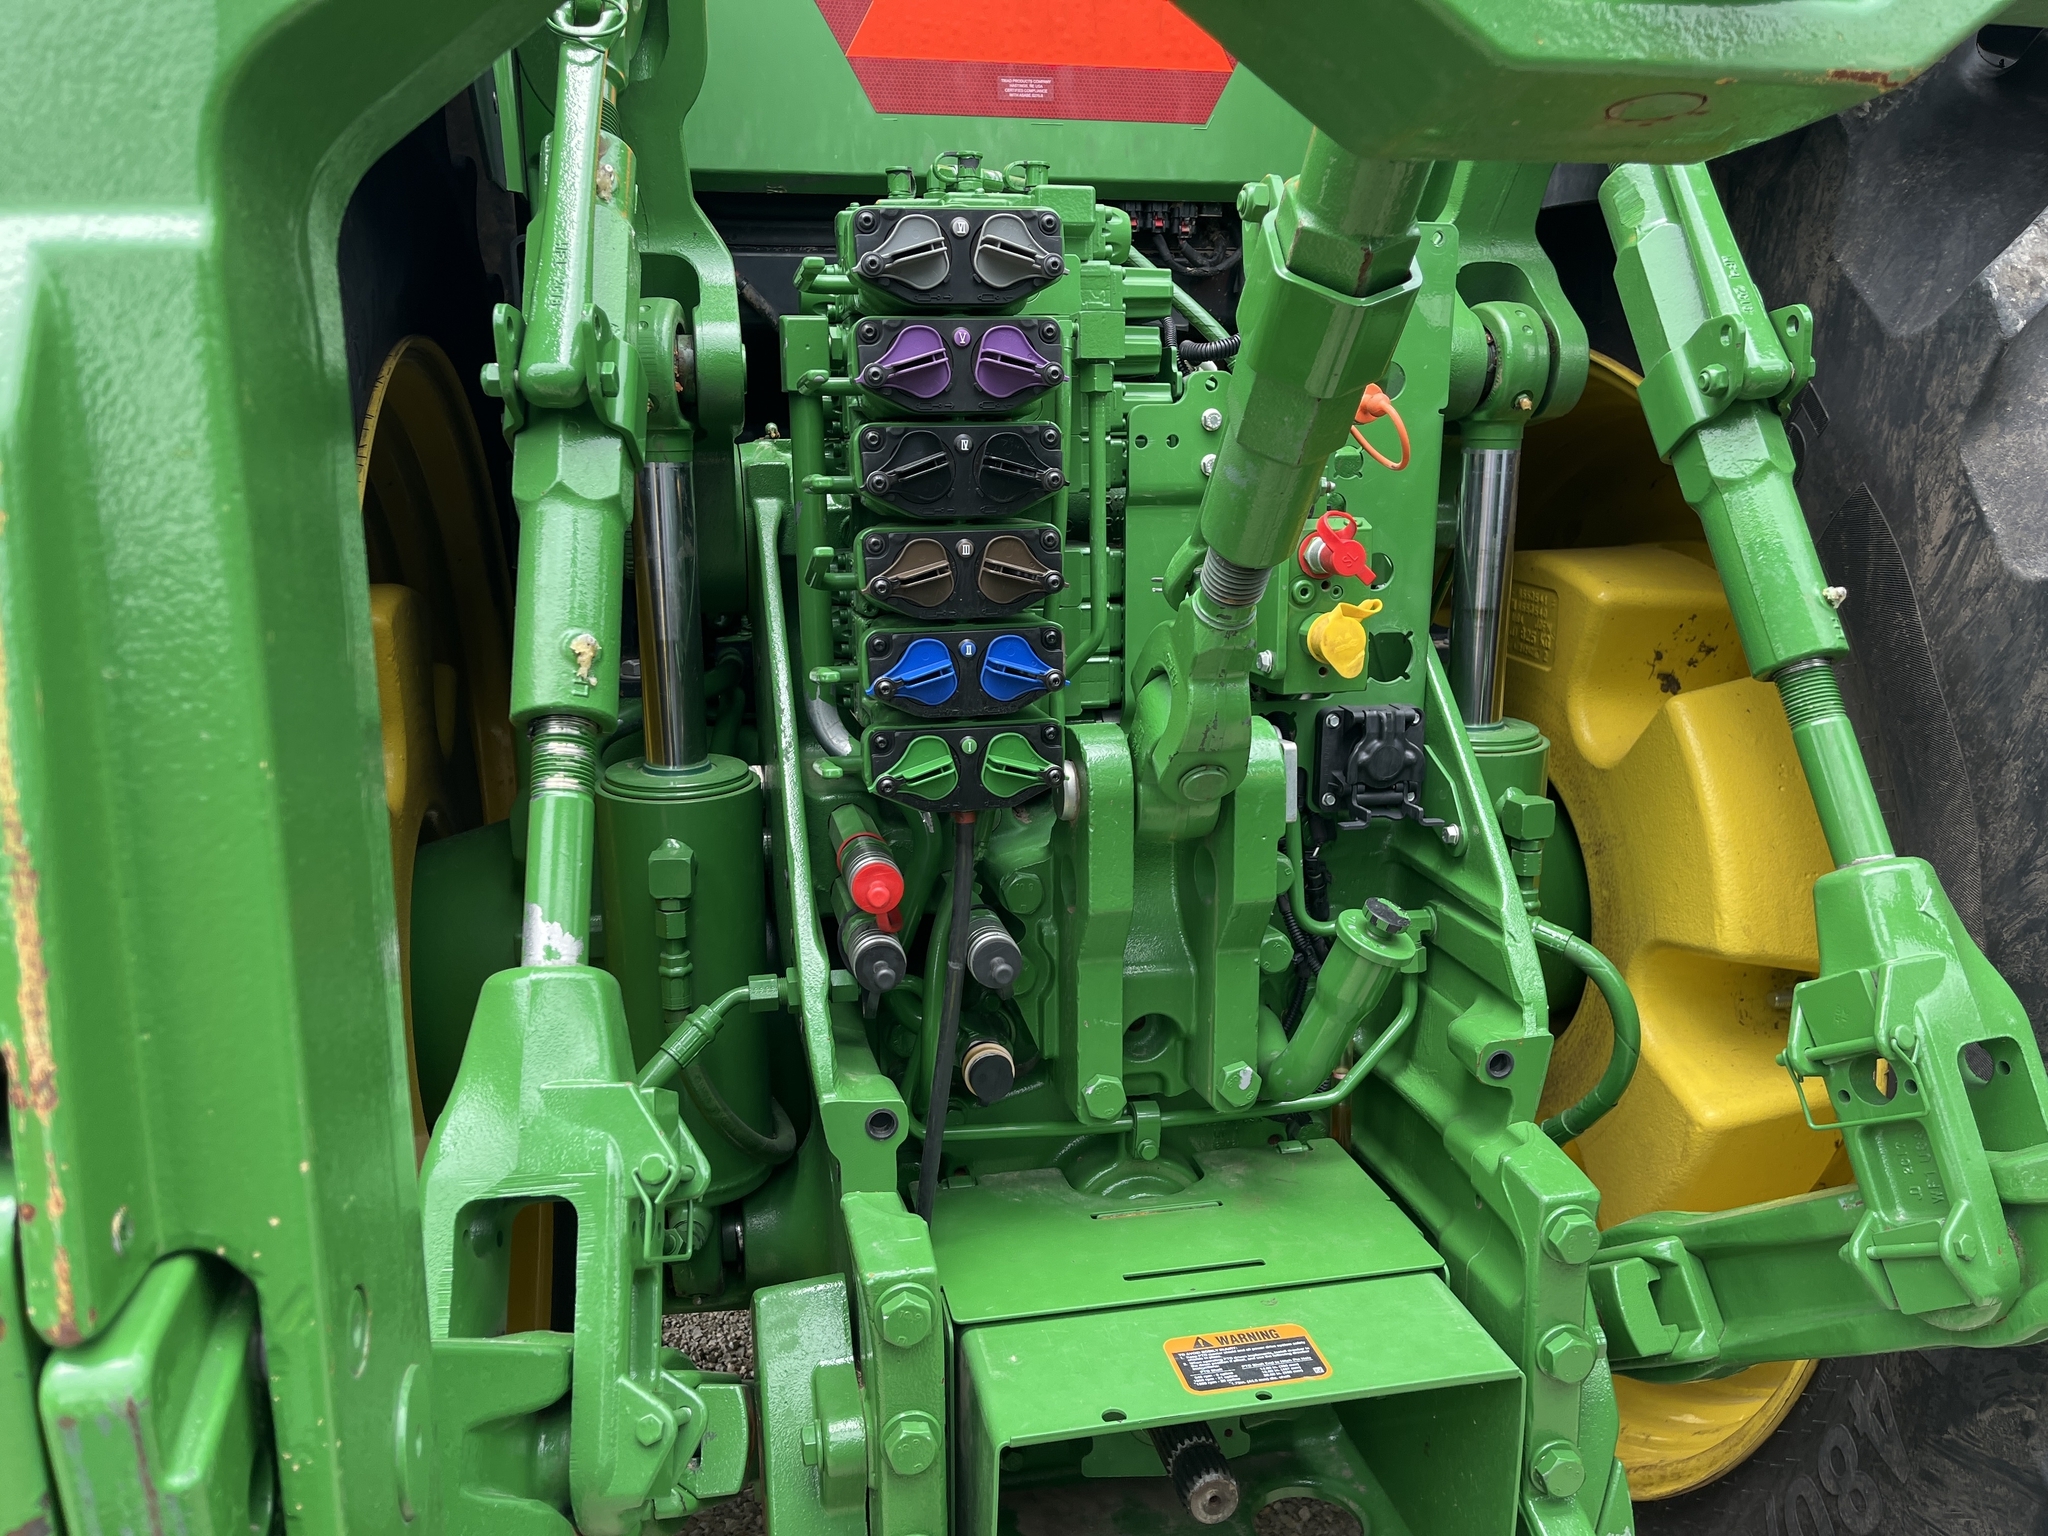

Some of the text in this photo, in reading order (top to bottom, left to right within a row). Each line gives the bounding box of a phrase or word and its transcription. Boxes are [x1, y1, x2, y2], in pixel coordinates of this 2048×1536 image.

[956, 222, 966, 233] VI
[958, 332, 967, 343] V
[960, 439, 969, 450] IV
[962, 544, 970, 555] III
[1342, 552, 1358, 568] SL
[965, 644, 972, 655] II
[1215, 1328, 1280, 1346] WARNING
